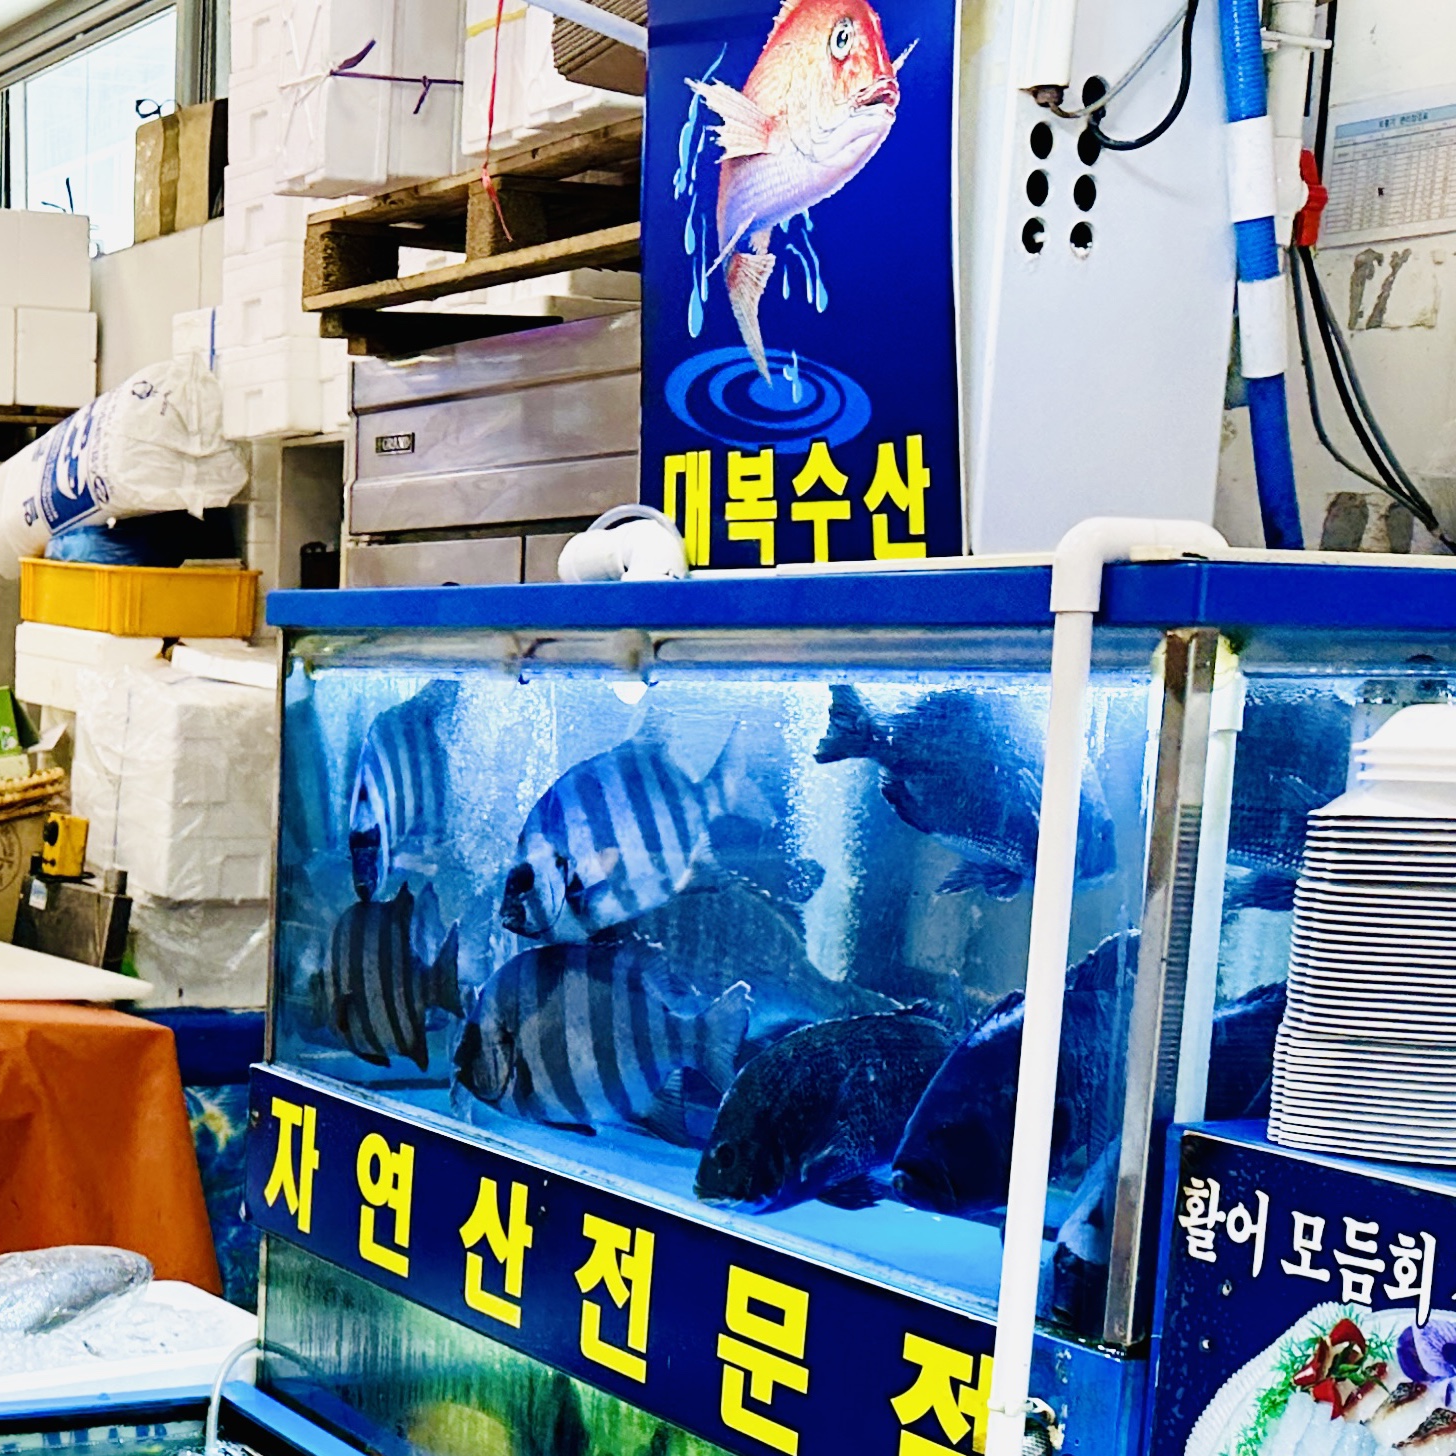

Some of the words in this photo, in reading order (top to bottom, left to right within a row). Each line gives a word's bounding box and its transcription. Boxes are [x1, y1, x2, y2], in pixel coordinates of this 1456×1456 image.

[663, 434, 931, 567] 대복수산
[1178, 1177, 1269, 1278] 활어
[1281, 1211, 1436, 1327] 모듬회
